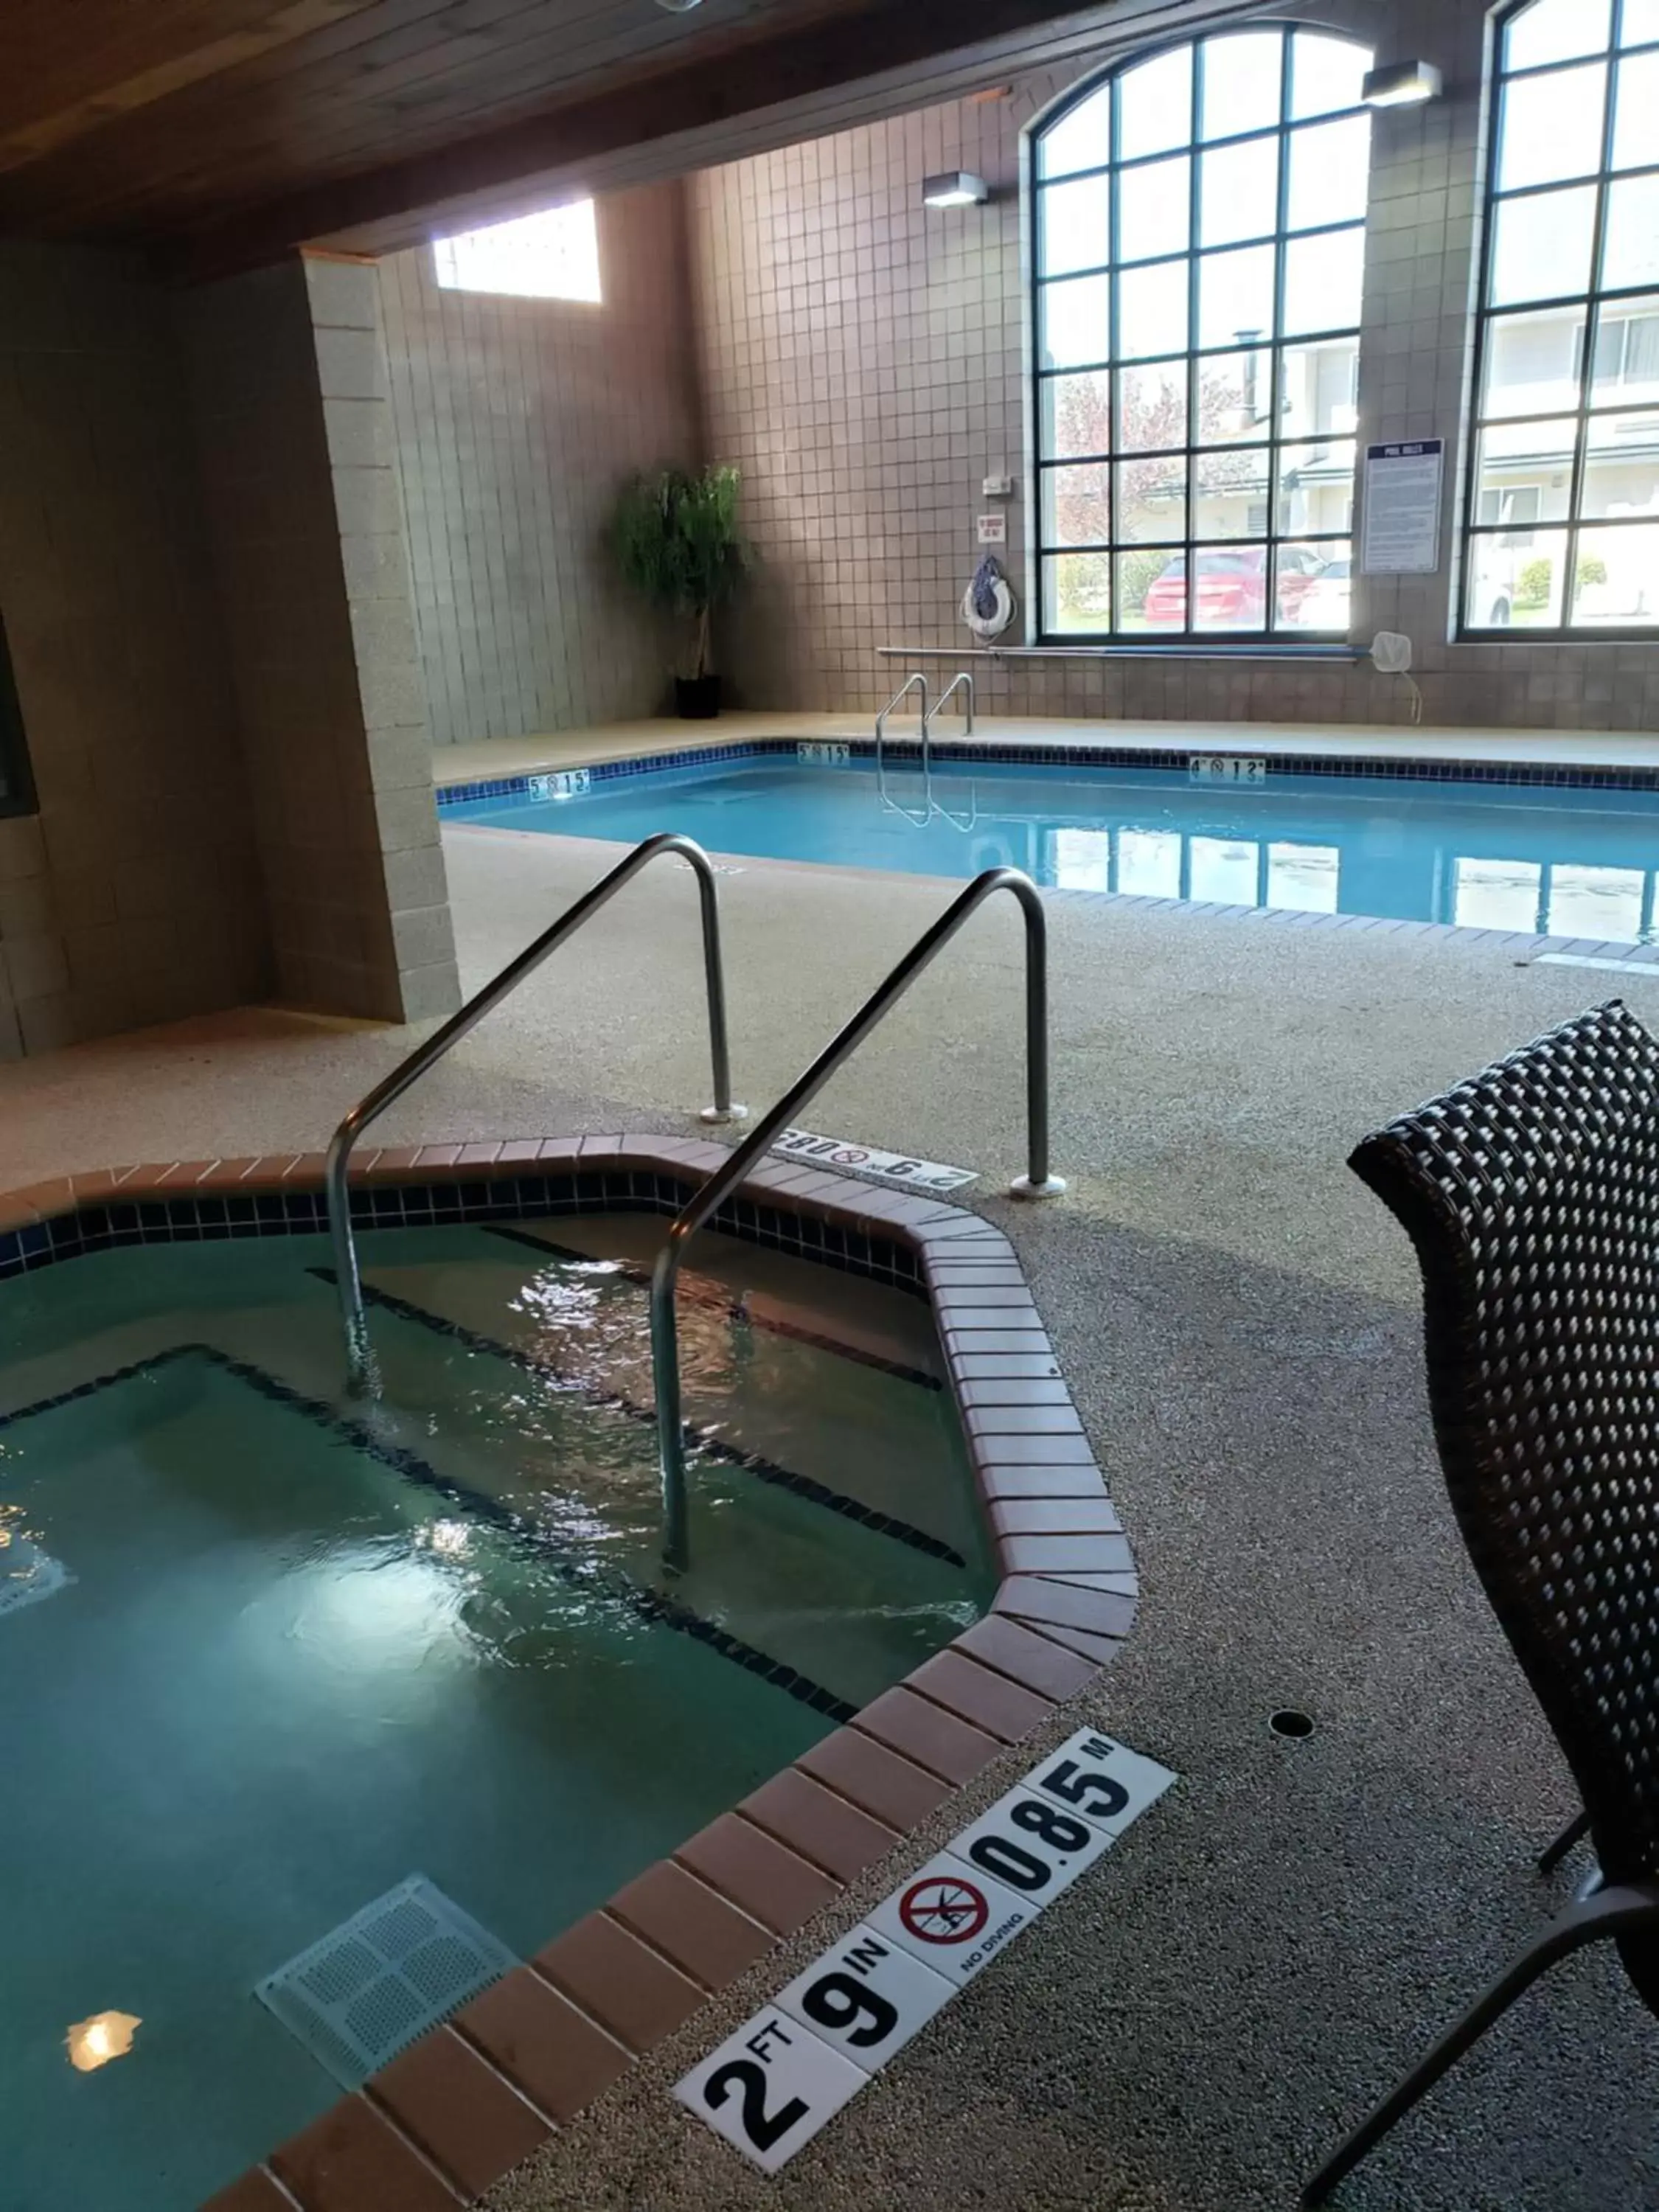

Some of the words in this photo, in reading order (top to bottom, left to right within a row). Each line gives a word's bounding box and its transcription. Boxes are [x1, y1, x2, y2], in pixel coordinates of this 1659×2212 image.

[969, 1759, 1130, 1891] 0.85
[1079, 1737, 1115, 1761] M
[841, 1936, 891, 1977] IN
[960, 1951, 983, 1973] NO
[981, 1913, 1025, 1952] DIVING
[745, 2019, 793, 2065] FT
[801, 1971, 899, 2048] 9
[703, 2059, 810, 2154] 2
